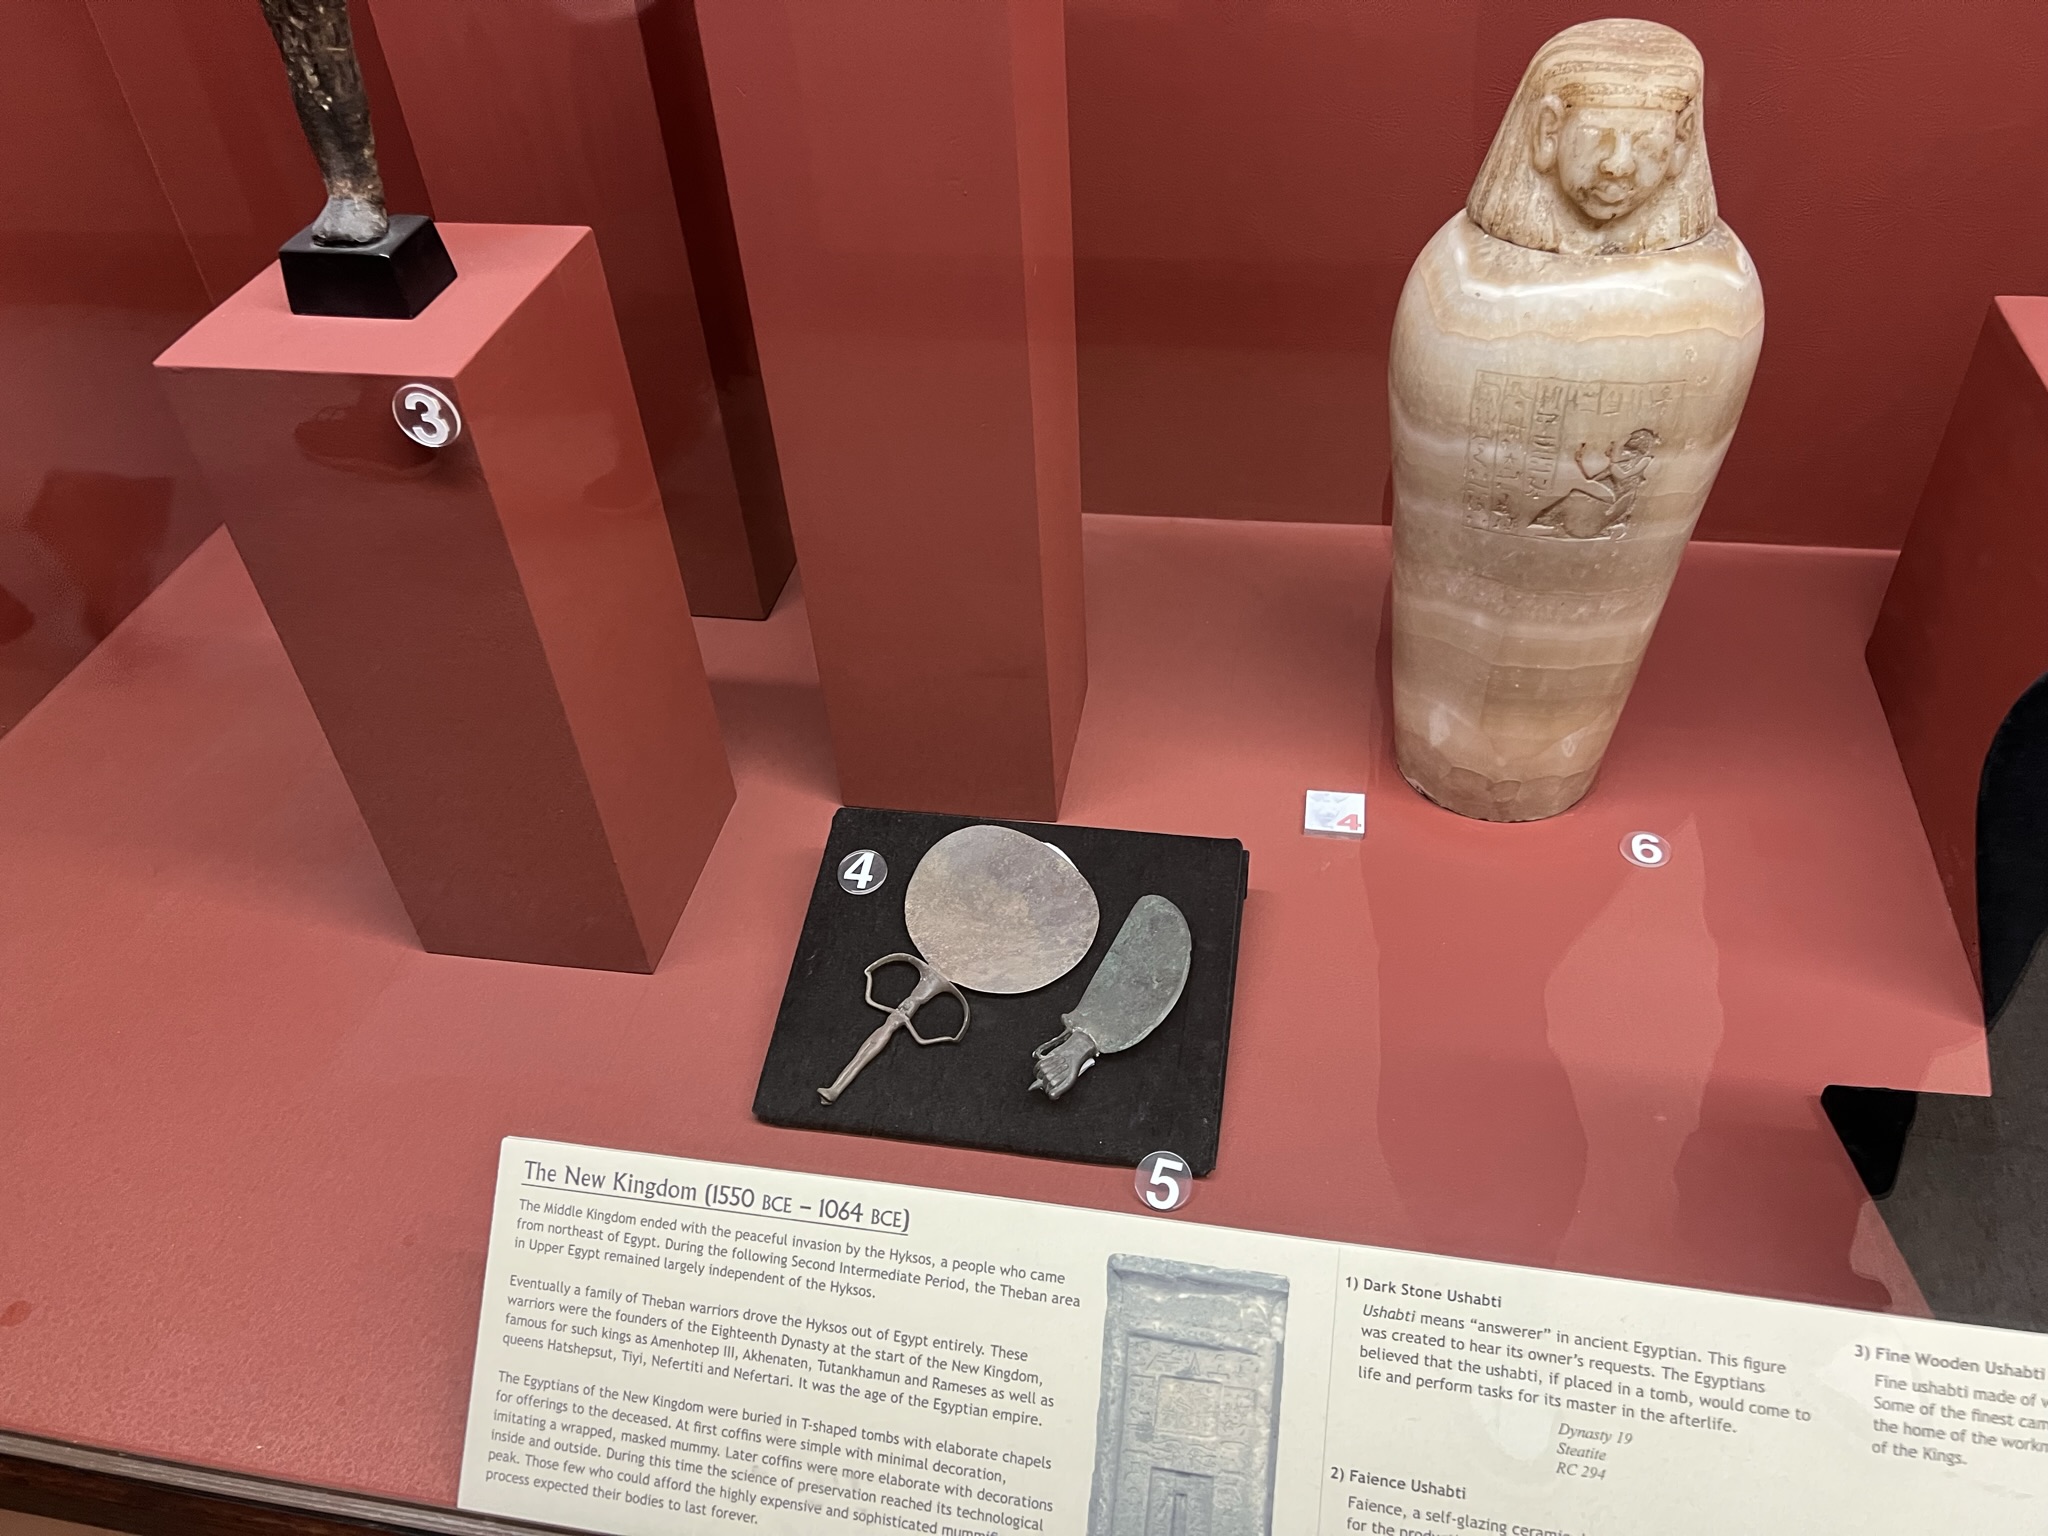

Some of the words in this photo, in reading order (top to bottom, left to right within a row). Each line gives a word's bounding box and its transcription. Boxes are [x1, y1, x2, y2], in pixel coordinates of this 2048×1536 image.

[404, 392, 449, 445] 3
[1336, 813, 1362, 831] 4
[1631, 833, 1663, 864] 6
[843, 852, 875, 889] 4
[524, 1160, 557, 1183] The
[564, 1164, 607, 1189] New
[612, 1171, 697, 1202] Kingdom
[704, 1183, 755, 1208] (1550
[761, 1194, 793, 1214] BCE
[818, 1198, 864, 1223] 1064
[870, 1208, 910, 1233] BCE)
[1146, 1157, 1183, 1210] 5
[519, 1198, 541, 1213] The
[543, 1202, 583, 1218] Middle
[586, 1207, 637, 1228] Kingdom
[639, 1216, 678, 1231] ended
[680, 1221, 707, 1235] with
[711, 1224, 732, 1239] the
[734, 1230, 788, 1247] peaceful
[792, 1235, 842, 1254] invasion
[845, 1241, 861, 1259] by
[864, 1244, 886, 1260] the
[889, 1248, 936, 1269] Hyksos,
[940, 1258, 948, 1268] a
[951, 1259, 996, 1276] people
[999, 1264, 1027, 1279] who
[1030, 1270, 1066, 1285] came
[515, 1236, 525, 1249] in
[529, 1238, 565, 1255] Upper
[567, 1244, 600, 1261] Egypt
[604, 1251, 661, 1268] remained
[664, 1257, 705, 1277] largely
[709, 1263, 785, 1286] independent
[788, 1275, 803, 1288] of
[806, 1277, 826, 1291] the
[830, 1280, 875, 1299] Hyksos.
[516, 1217, 545, 1233] from
[547, 1224, 604, 1241] northeast
[607, 1228, 621, 1243] of
[623, 1230, 660, 1250] Egypt.
[665, 1237, 704, 1257] During
[707, 1243, 729, 1258] the
[731, 1245, 788, 1269] following
[790, 1254, 836, 1273] Second
[839, 1261, 922, 1285] Intermediate
[924, 1273, 969, 1294] Period,
[974, 1280, 996, 1295] the
[999, 1282, 1048, 1303] Theban
[1051, 1294, 1080, 1308] area
[1345, 1276, 1359, 1292] 1)
[1363, 1278, 1397, 1295] Dark
[1400, 1283, 1443, 1300] Stone
[1447, 1289, 1502, 1308] Ushabti
[509, 1274, 572, 1297] Eventually
[573, 1286, 581, 1296] a
[585, 1285, 623, 1305] family
[625, 1291, 639, 1304] of
[641, 1293, 686, 1312] Theban
[689, 1302, 739, 1319] warriors
[742, 1308, 778, 1325] drove
[781, 1314, 803, 1328] the
[805, 1317, 848, 1335] Hyksos
[851, 1326, 873, 1339] out
[876, 1328, 890, 1341] of
[893, 1329, 929, 1349] Egypt
[932, 1338, 985, 1358] entirely.
[990, 1344, 1028, 1362] These
[1362, 1303, 1417, 1323] Ushabti
[1420, 1314, 1465, 1330] means
[1556, 1330, 1570, 1344] in
[1574, 1335, 1630, 1353] ancient
[1633, 1340, 1702, 1363] Egyptian.
[1707, 1350, 1739, 1368] This
[1743, 1356, 1787, 1374] figure
[1361, 1327, 1387, 1340] was
[1391, 1331, 1446, 1348] created
[1450, 1337, 1465, 1351] to
[1469, 1338, 1502, 1355] hear
[1506, 1344, 1524, 1359] its
[1589, 1359, 1656, 1378] requests.
[1660, 1366, 1690, 1382] The
[1694, 1371, 1766, 1393] Egyptians
[1854, 1345, 1871, 1361] 3)
[1876, 1347, 1910, 1364] Fine
[1915, 1352, 1980, 1372] Wooden
[1985, 1361, 2045, 1380] Ushabti
[1358, 1365, 1382, 1381] life
[1385, 1372, 1412, 1386] and
[1415, 1376, 1473, 1395] perform
[1477, 1384, 1514, 1400] tasks
[1518, 1388, 1540, 1404] for
[1543, 1392, 1562, 1408] its
[1566, 1399, 1618, 1415] master
[1621, 1403, 1635, 1418] in
[1640, 1407, 1667, 1423] the
[1669, 1412, 1738, 1433] afterlife.
[1359, 1344, 1420, 1365] believed
[1424, 1354, 1453, 1371] that
[1457, 1359, 1482, 1374] the
[1485, 1364, 1543, 1386] ushabti,
[1548, 1371, 1561, 1385] if
[1564, 1374, 1613, 1393] placed
[1617, 1381, 1631, 1396] in
[1635, 1387, 1645, 1398] a
[1650, 1387, 1693, 1408] tomb,
[1699, 1396, 1745, 1412] would
[1748, 1403, 1791, 1419] come
[1795, 1408, 1812, 1422] to
[1875, 1374, 1908, 1390] Fine
[1912, 1378, 1969, 1398] ushabti
[1973, 1390, 2017, 1404] made
[2020, 1394, 2037, 1406] of
[1874, 1396, 1915, 1413] Some
[1919, 1404, 1936, 1416] of
[1941, 1405, 1967, 1420] the
[1971, 1409, 2015, 1427] finest
[1557, 1423, 1613, 1445] Dynasty
[1616, 1431, 1633, 1444] 19
[1874, 1419, 1899, 1433] the
[1903, 1421, 1947, 1440] home
[1950, 1429, 1967, 1443] of
[1972, 1431, 1998, 1446] the
[1556, 1442, 1607, 1461] Steatite
[1872, 1441, 1888, 1454] of
[1893, 1443, 1918, 1458] the
[1923, 1447, 1967, 1466] Kings.
[1330, 1466, 1345, 1483] 2)
[1349, 1469, 1406, 1490] Faience
[1411, 1479, 1466, 1500] Ushabti
[1555, 1461, 1579, 1476] RC
[1580, 1465, 1607, 1481] 294
[485, 1470, 530, 1486] process
[533, 1478, 589, 1496] expected
[592, 1485, 622, 1501] their
[625, 1490, 664, 1509] bodies
[668, 1498, 681, 1511] to
[685, 1499, 707, 1516] last
[711, 1504, 758, 1525] forever.
[1348, 1495, 1408, 1521] Faience,
[1412, 1509, 1422, 1520] a
[1425, 1509, 1508, 1536] self-glazing
[1346, 1516, 1368, 1532] for
[1371, 1521, 1396, 1536] the
